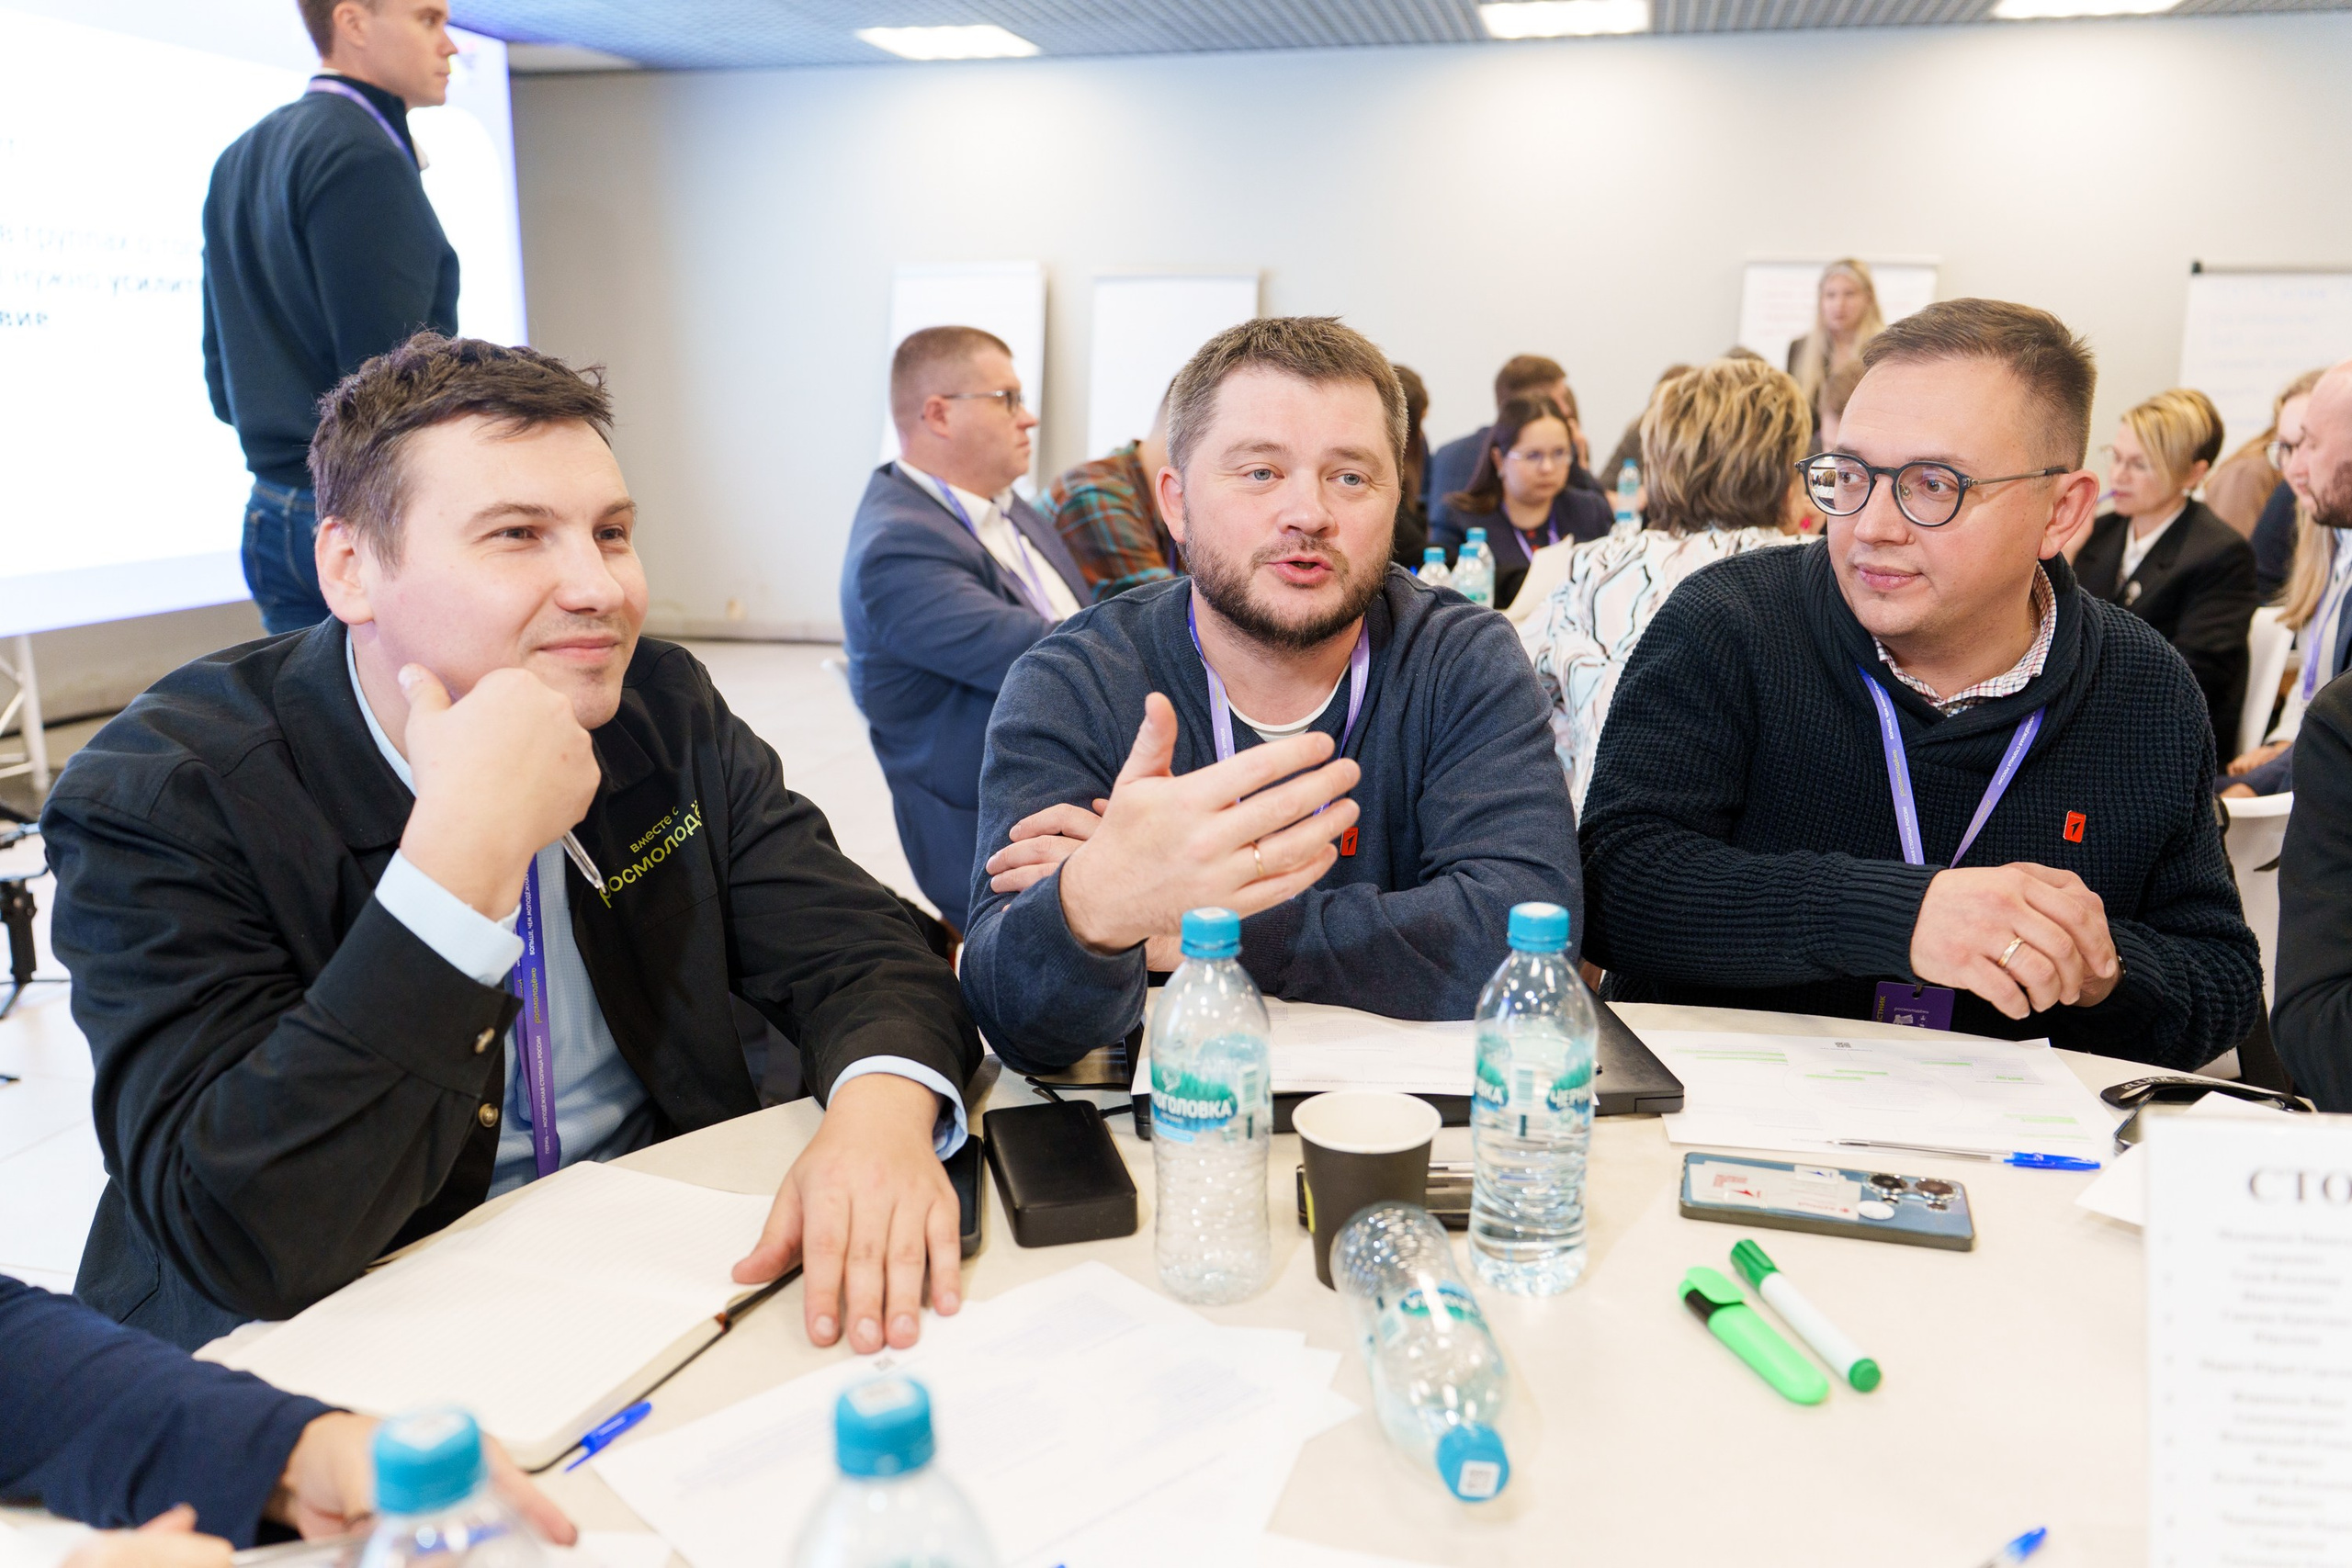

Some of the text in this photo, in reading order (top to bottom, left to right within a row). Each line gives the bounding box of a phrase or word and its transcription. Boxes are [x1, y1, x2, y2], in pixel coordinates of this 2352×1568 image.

[599, 799, 703, 908] росмолодё
[629, 806, 679, 853] вместе с
